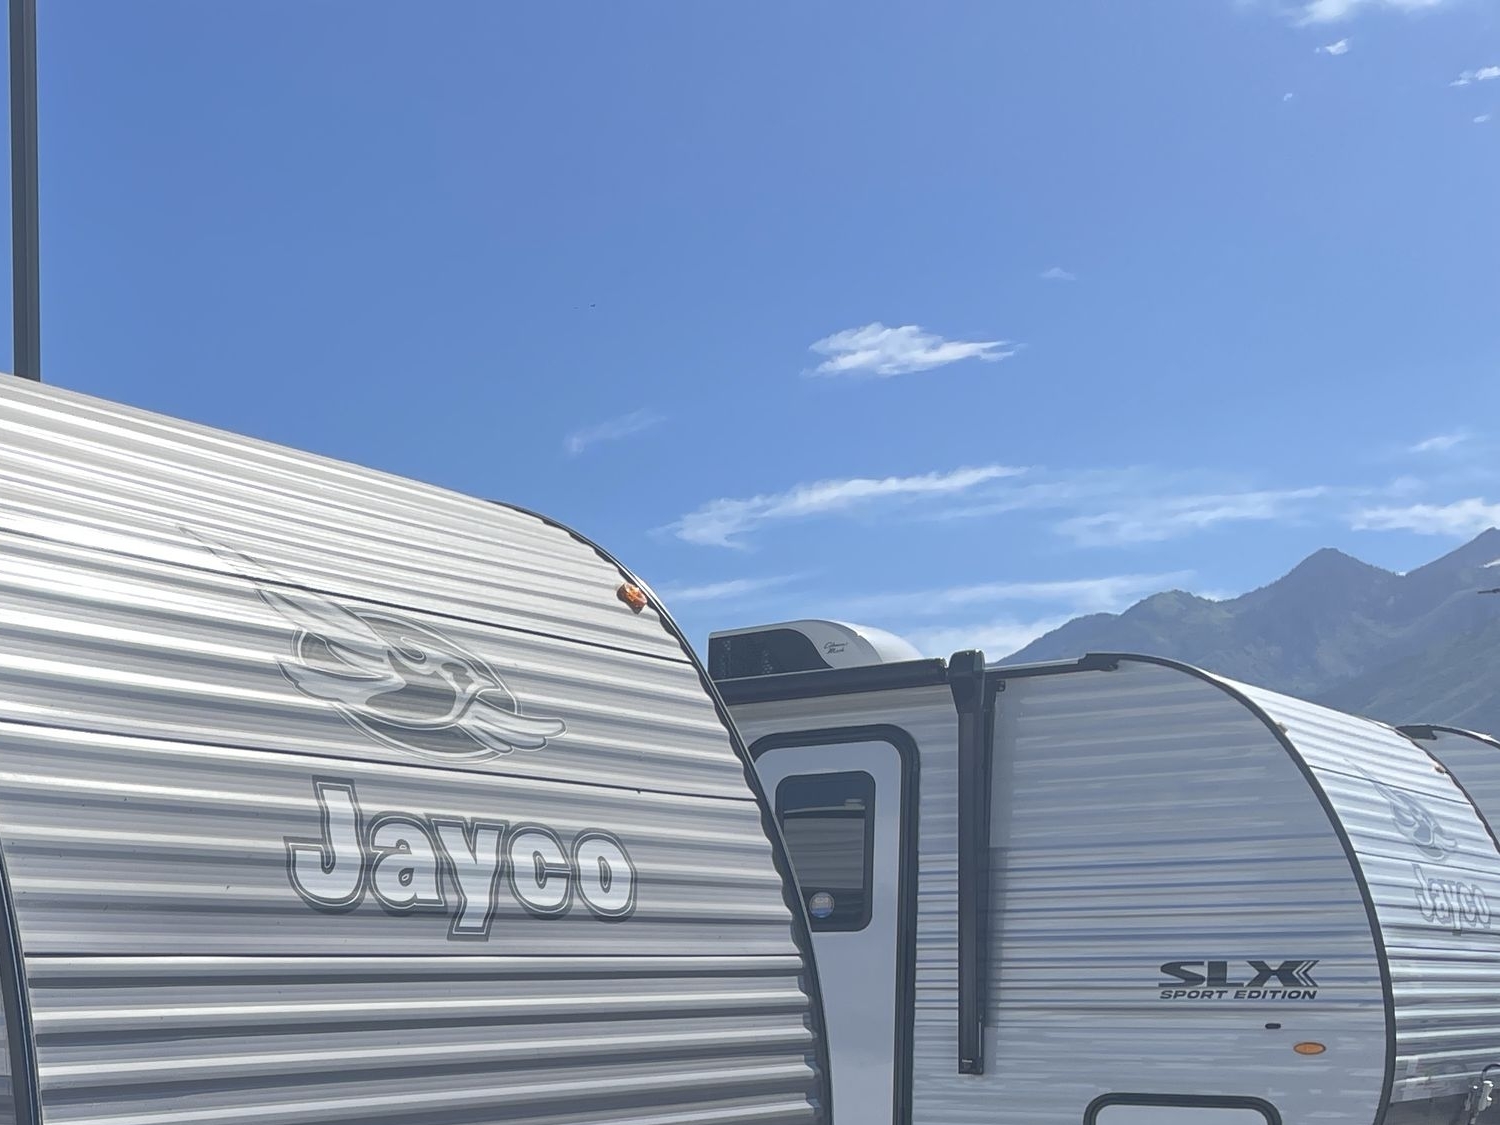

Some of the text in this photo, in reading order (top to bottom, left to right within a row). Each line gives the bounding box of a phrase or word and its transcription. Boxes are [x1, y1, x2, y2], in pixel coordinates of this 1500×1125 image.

[283, 775, 638, 942] Jayco
[1411, 863, 1492, 937] Jayco
[1158, 960, 1319, 988] SLX
[1160, 990, 1318, 1000] SPORT EDITION
